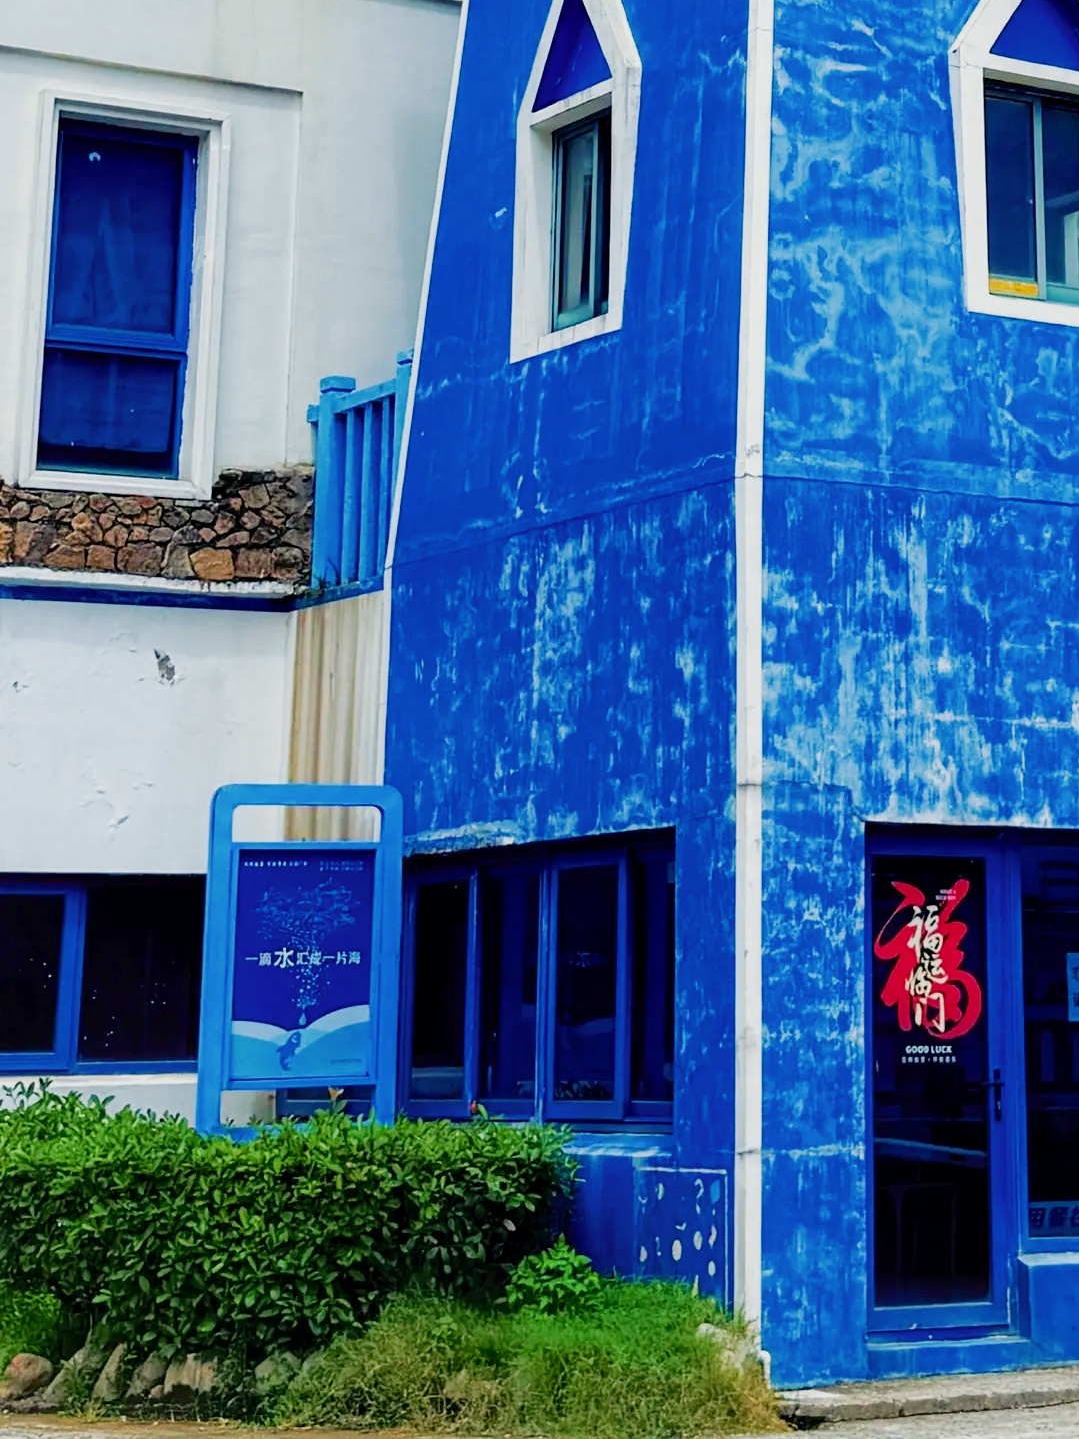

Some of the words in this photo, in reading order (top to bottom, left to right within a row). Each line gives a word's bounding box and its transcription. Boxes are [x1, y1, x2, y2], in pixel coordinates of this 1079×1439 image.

[245, 946, 361, 969] 一滴水汇成一片海
